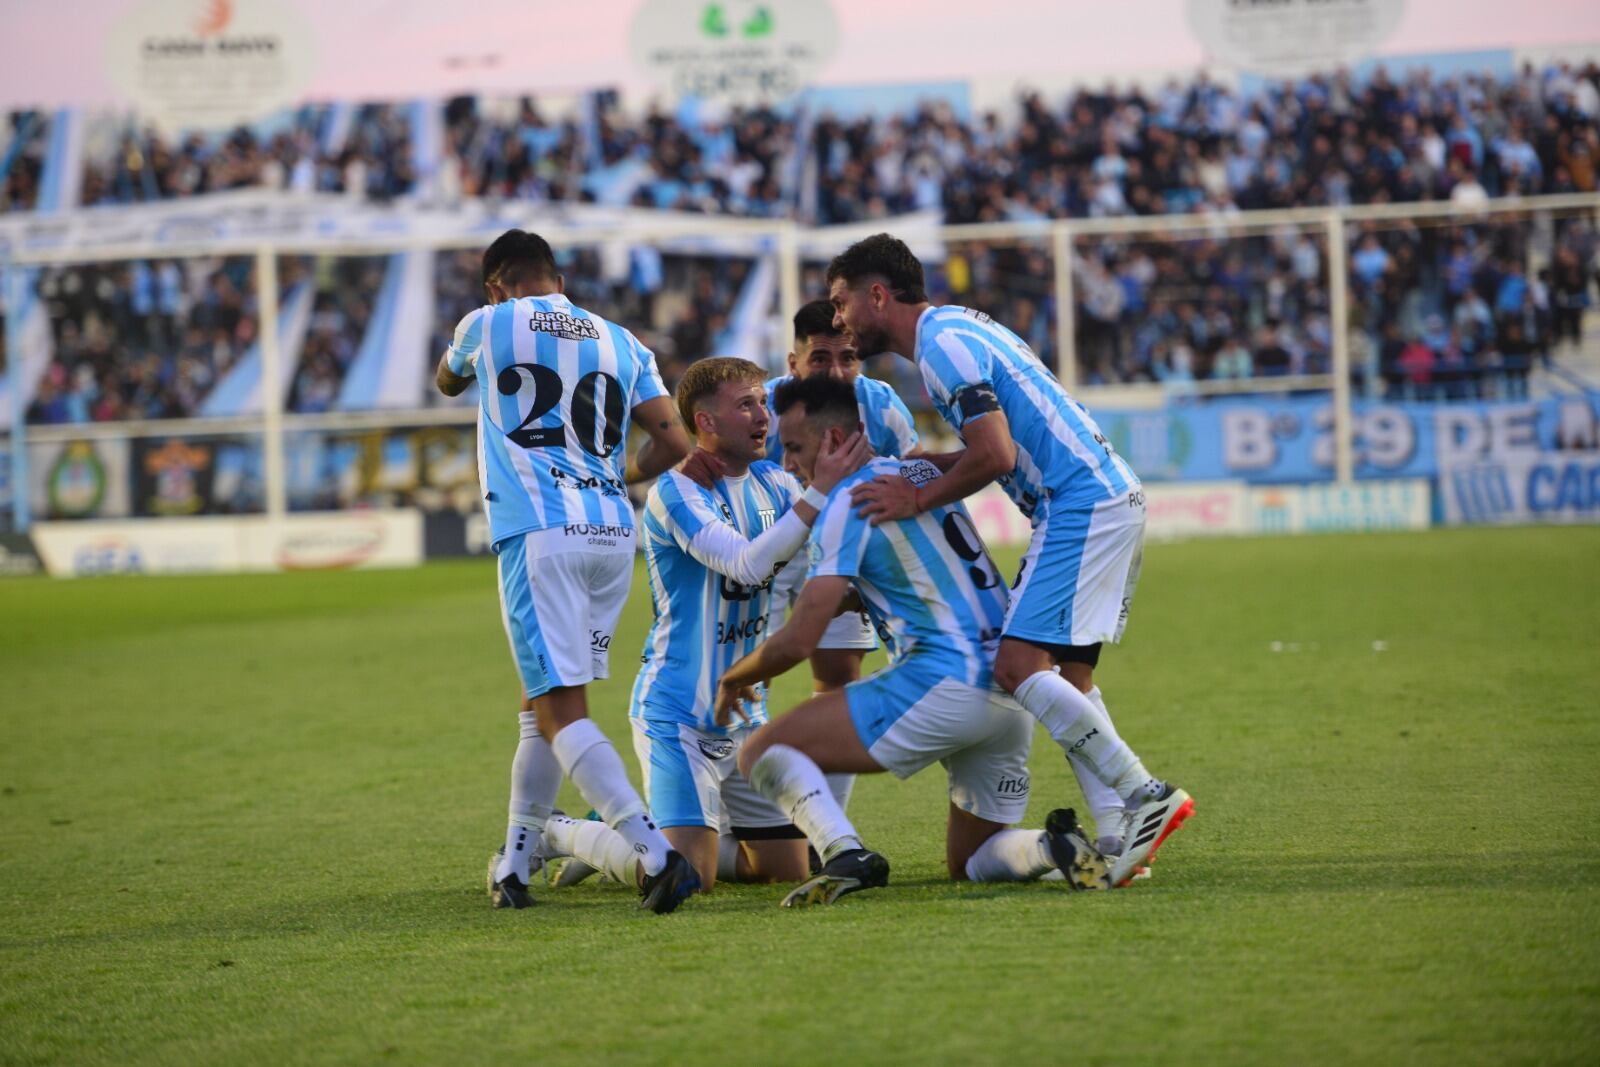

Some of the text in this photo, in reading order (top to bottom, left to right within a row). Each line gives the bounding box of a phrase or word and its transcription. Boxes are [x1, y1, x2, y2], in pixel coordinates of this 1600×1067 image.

[530, 320, 599, 339] FRESCAS
[534, 311, 592, 329] BROSAS
[497, 363, 624, 459] 20
[1436, 404, 1542, 462] DE
[564, 523, 631, 538] ROSARIO
[588, 537, 617, 547] chateau
[943, 511, 1000, 590] 9
